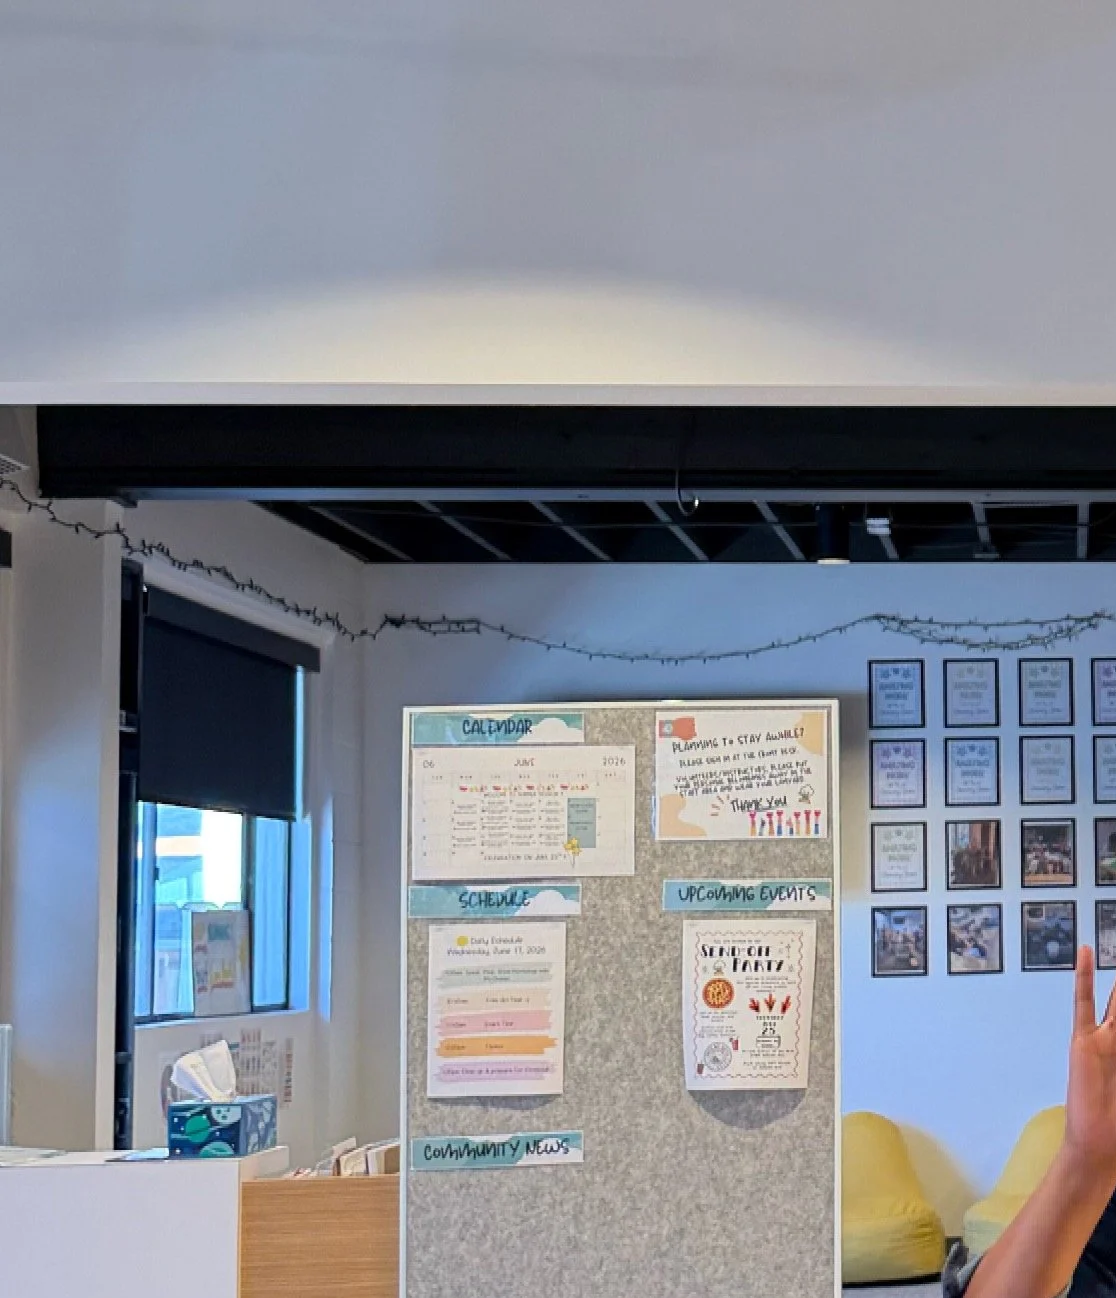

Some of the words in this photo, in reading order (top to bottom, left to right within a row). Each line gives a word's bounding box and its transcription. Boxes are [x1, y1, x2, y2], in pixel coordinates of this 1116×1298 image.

[462, 719, 533, 735] CALENDAR
[672, 742, 719, 754] PLANNING
[737, 734, 762, 745] STAY
[730, 797, 763, 812] THANK
[766, 795, 787, 807] YOU
[458, 890, 531, 909] SCHEDULE
[678, 886, 755, 902] UPCOMING
[760, 885, 817, 902] EVENTS
[732, 958, 785, 973] PARTY
[424, 1143, 519, 1160] COMMUNITY
[525, 1138, 570, 1156] NEWS
